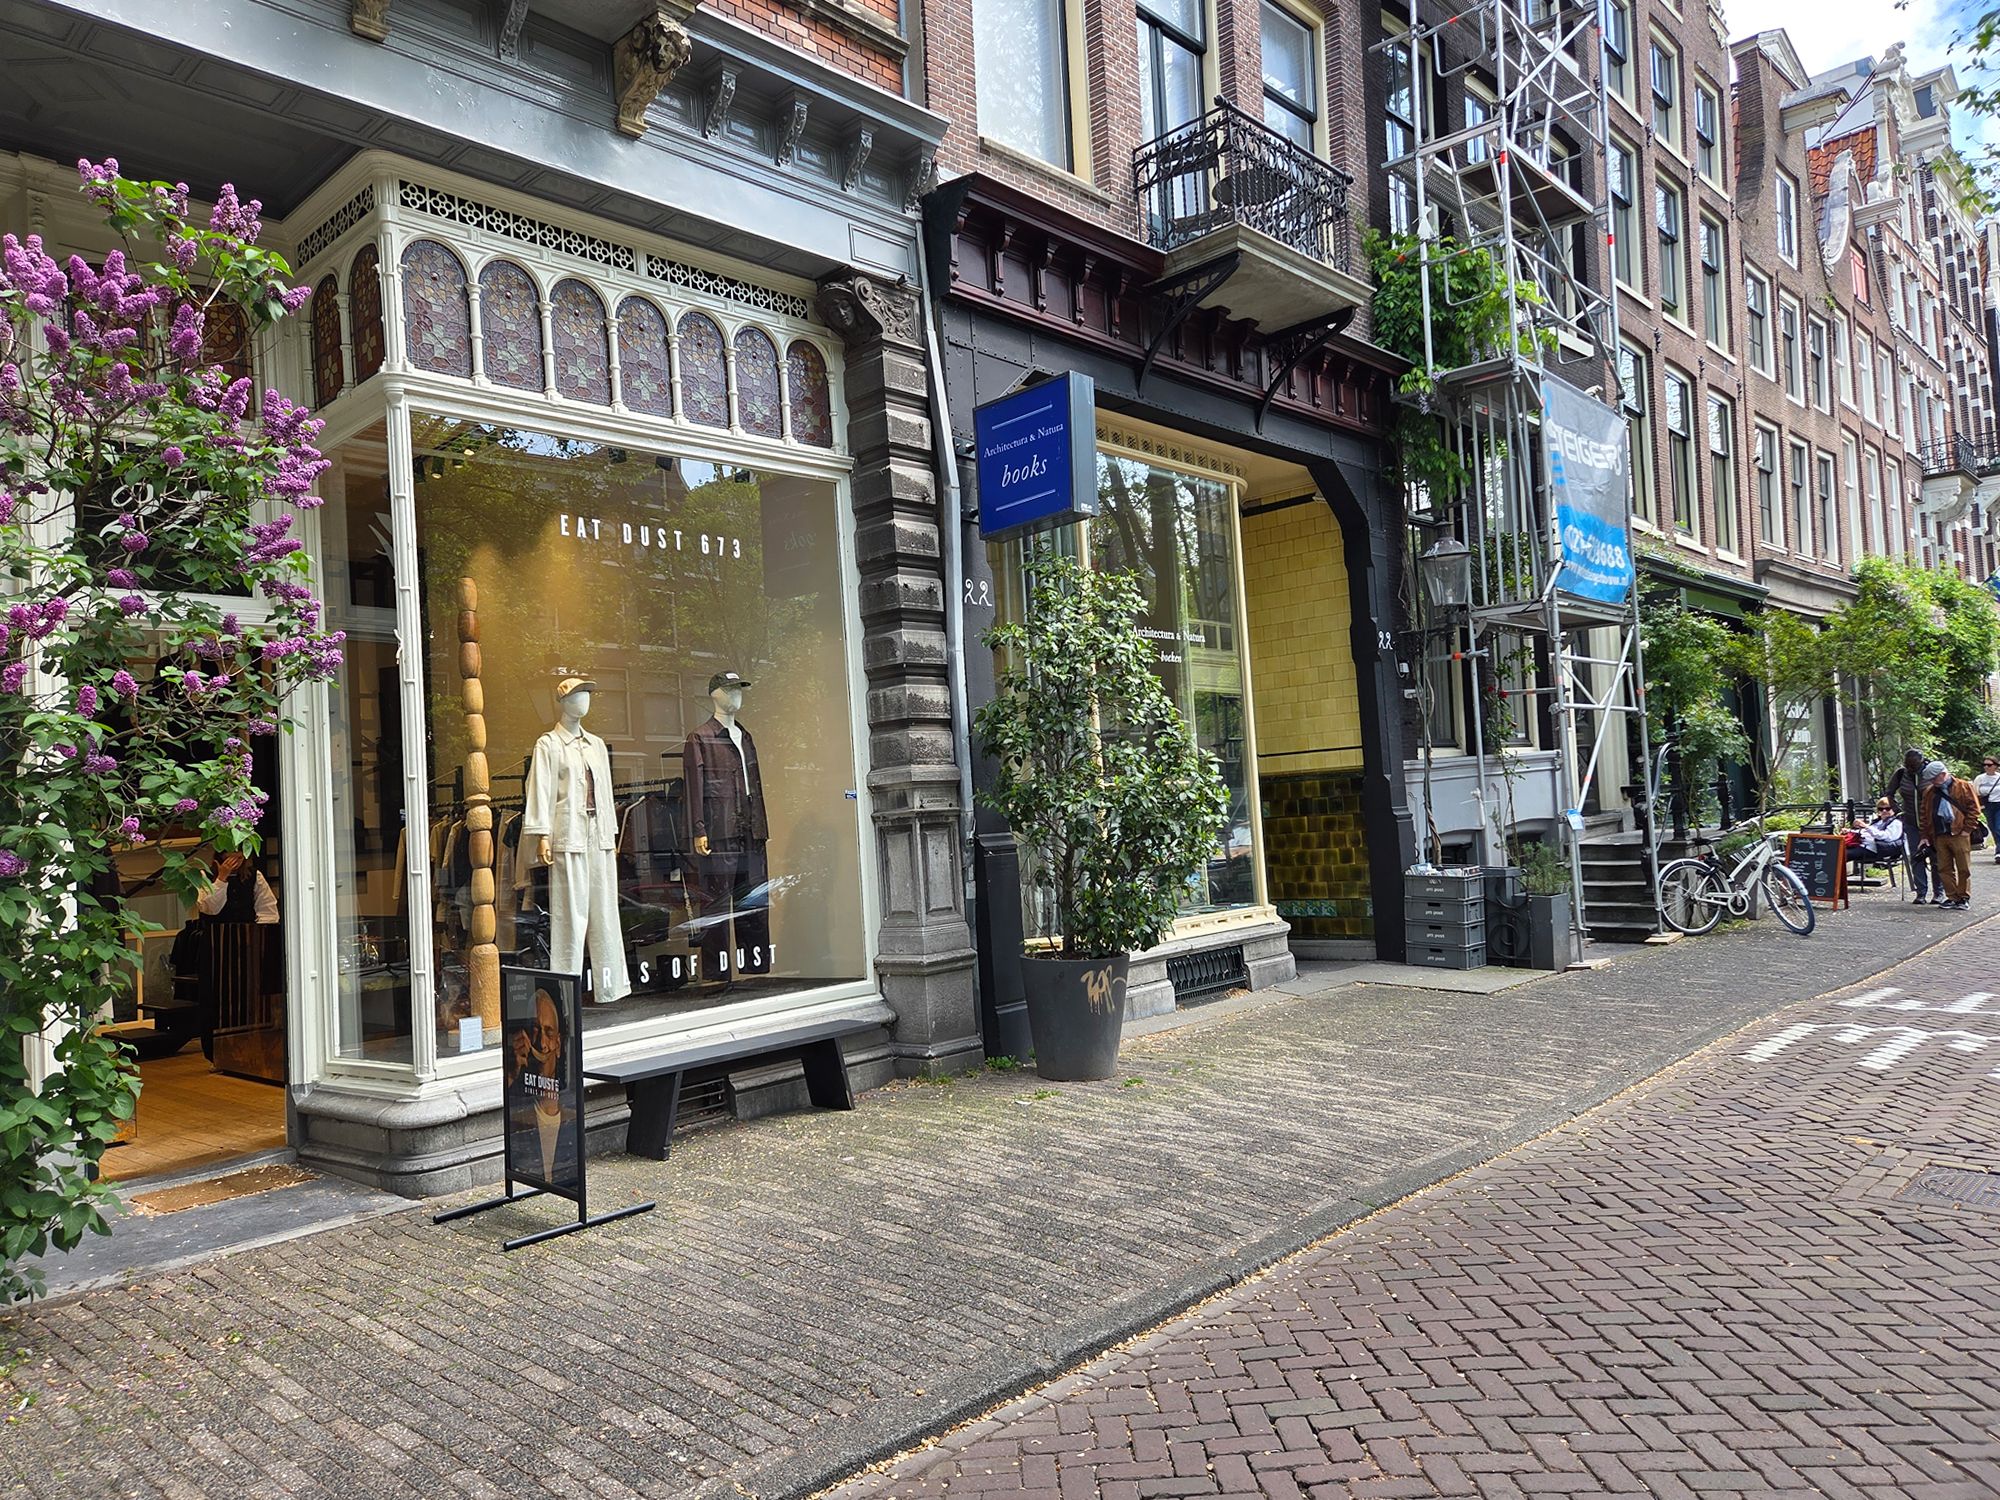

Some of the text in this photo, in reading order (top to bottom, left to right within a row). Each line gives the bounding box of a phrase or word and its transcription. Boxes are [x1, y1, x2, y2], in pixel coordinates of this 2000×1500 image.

[984, 424, 1064, 458] Architectura & Natura
[1002, 454, 1047, 487] books
[560, 514, 740, 559] EAT DUST 673
[1133, 625, 1175, 640] Architectura
[1183, 630, 1206, 643] Natura
[586, 944, 776, 991] IRLS OF DUST
[524, 1072, 537, 1087] EAT
[537, 1075, 555, 1091] DUST
